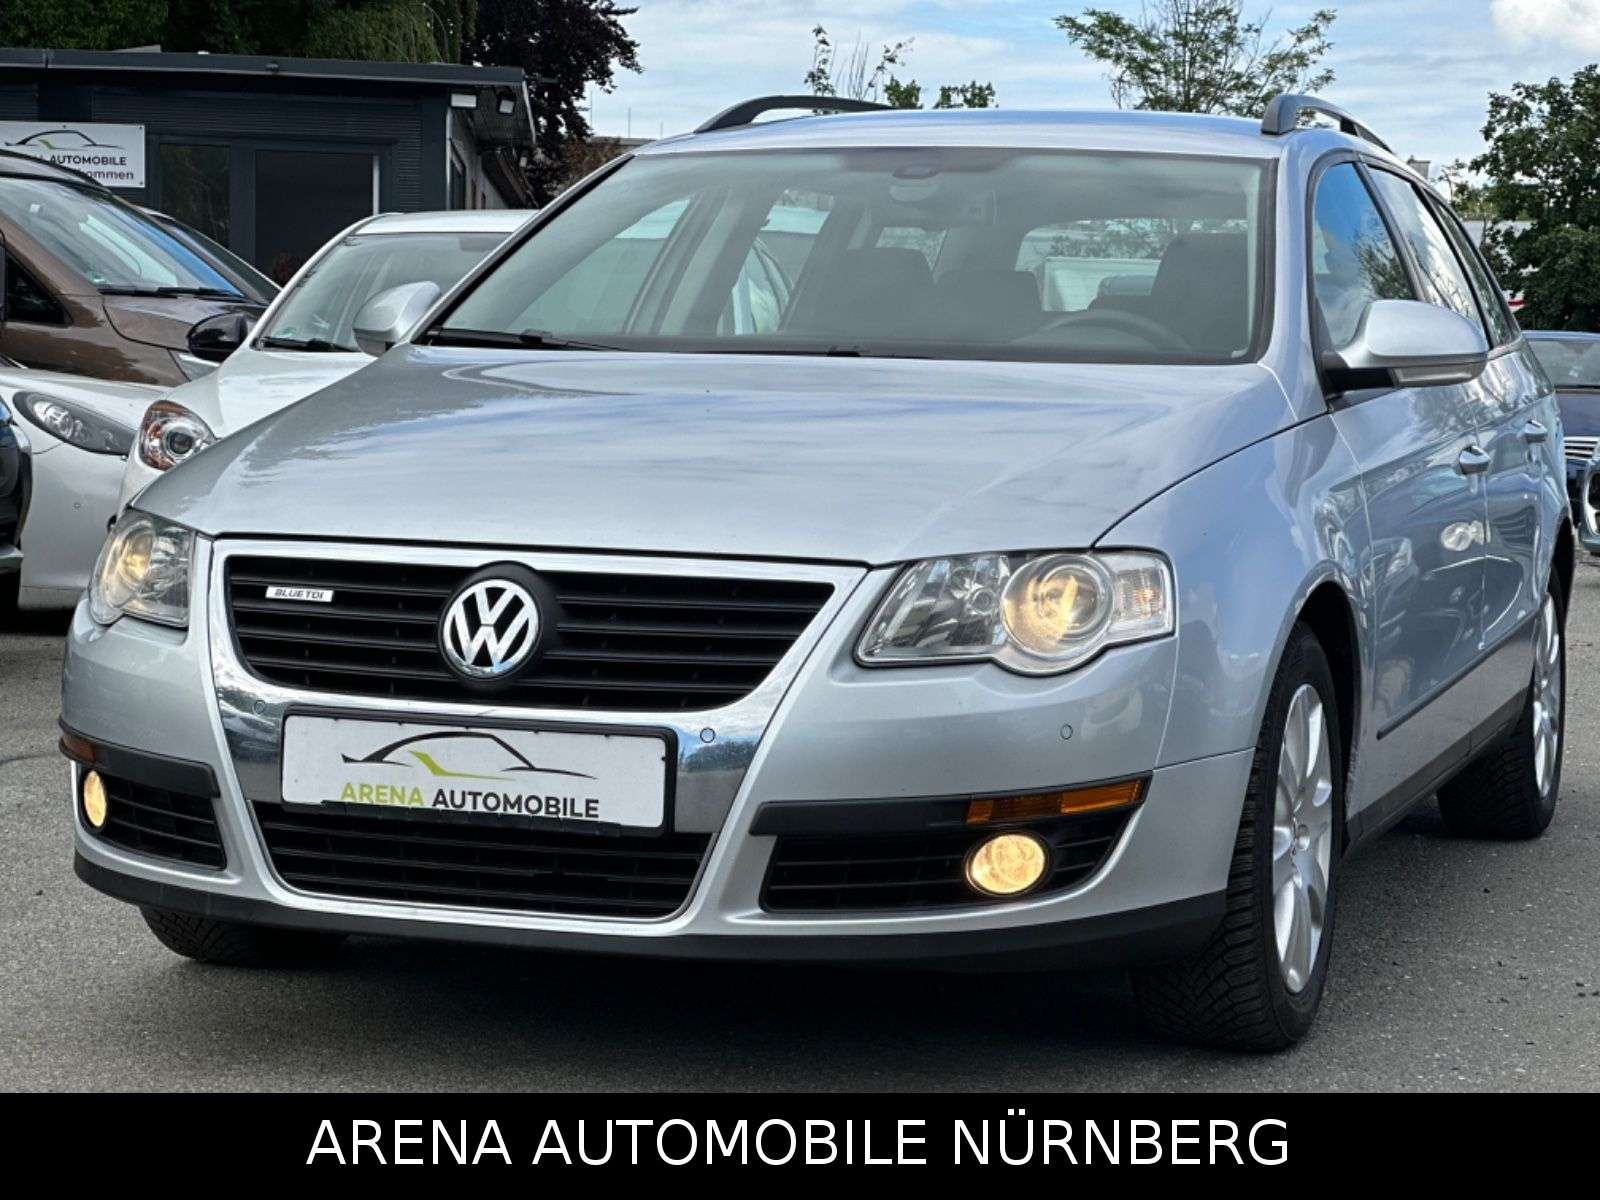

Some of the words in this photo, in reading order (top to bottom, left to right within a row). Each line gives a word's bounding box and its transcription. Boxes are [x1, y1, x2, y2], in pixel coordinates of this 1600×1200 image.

[50, 154, 127, 166] AUTOMOBILE
[444, 579, 540, 677] VW
[341, 782, 424, 806] ARENA
[432, 788, 600, 819] AUTOMOBILE
